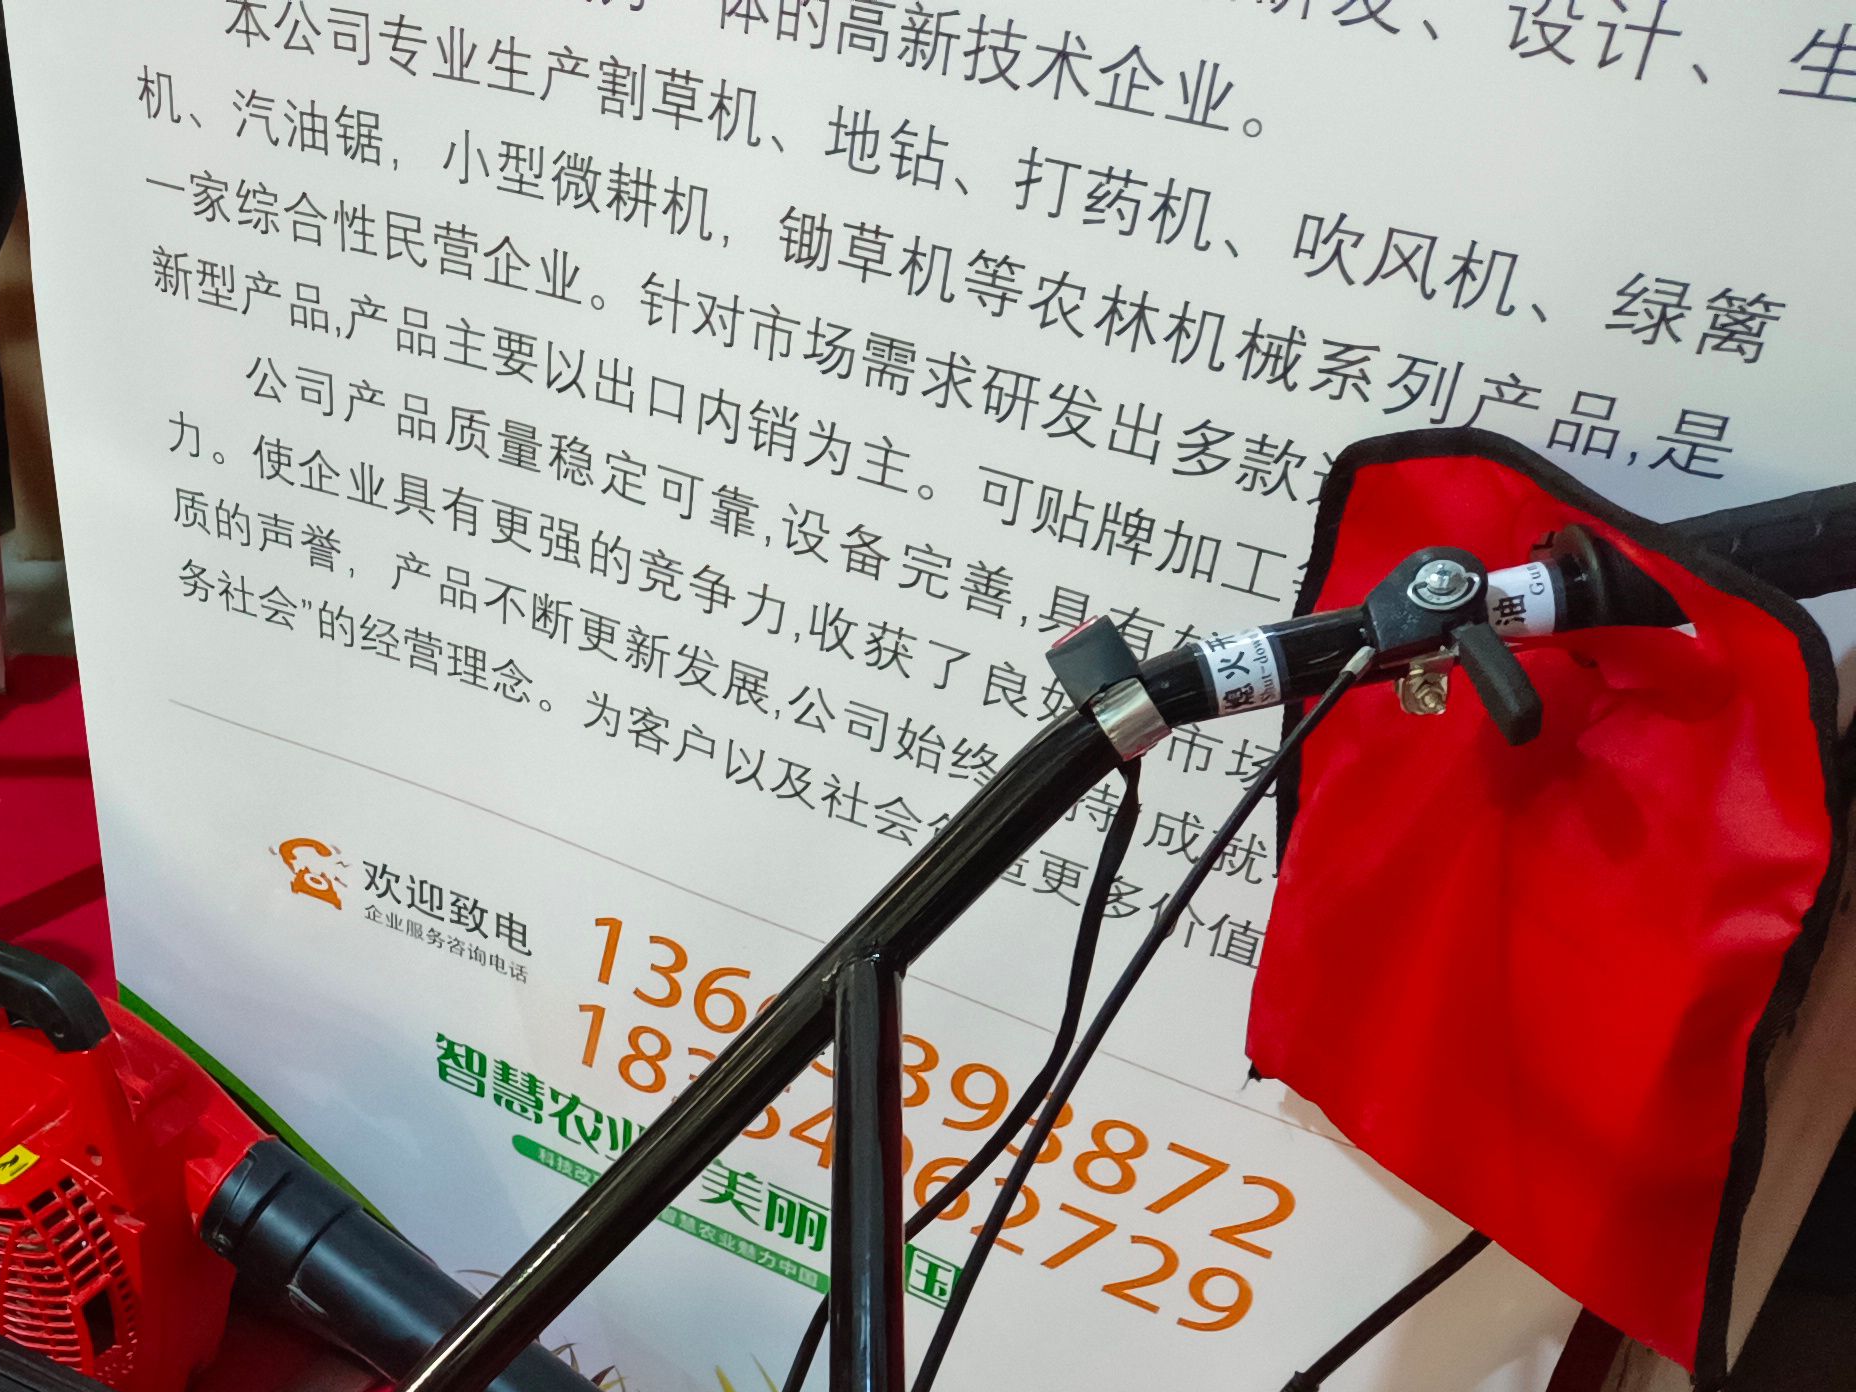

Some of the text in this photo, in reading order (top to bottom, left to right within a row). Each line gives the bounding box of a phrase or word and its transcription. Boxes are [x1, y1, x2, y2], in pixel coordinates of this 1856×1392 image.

[362, 860, 533, 957] 欢迎致电
[363, 903, 529, 985] 企业服务咨询电话
[698, 1158, 966, 1310] 美丽国
